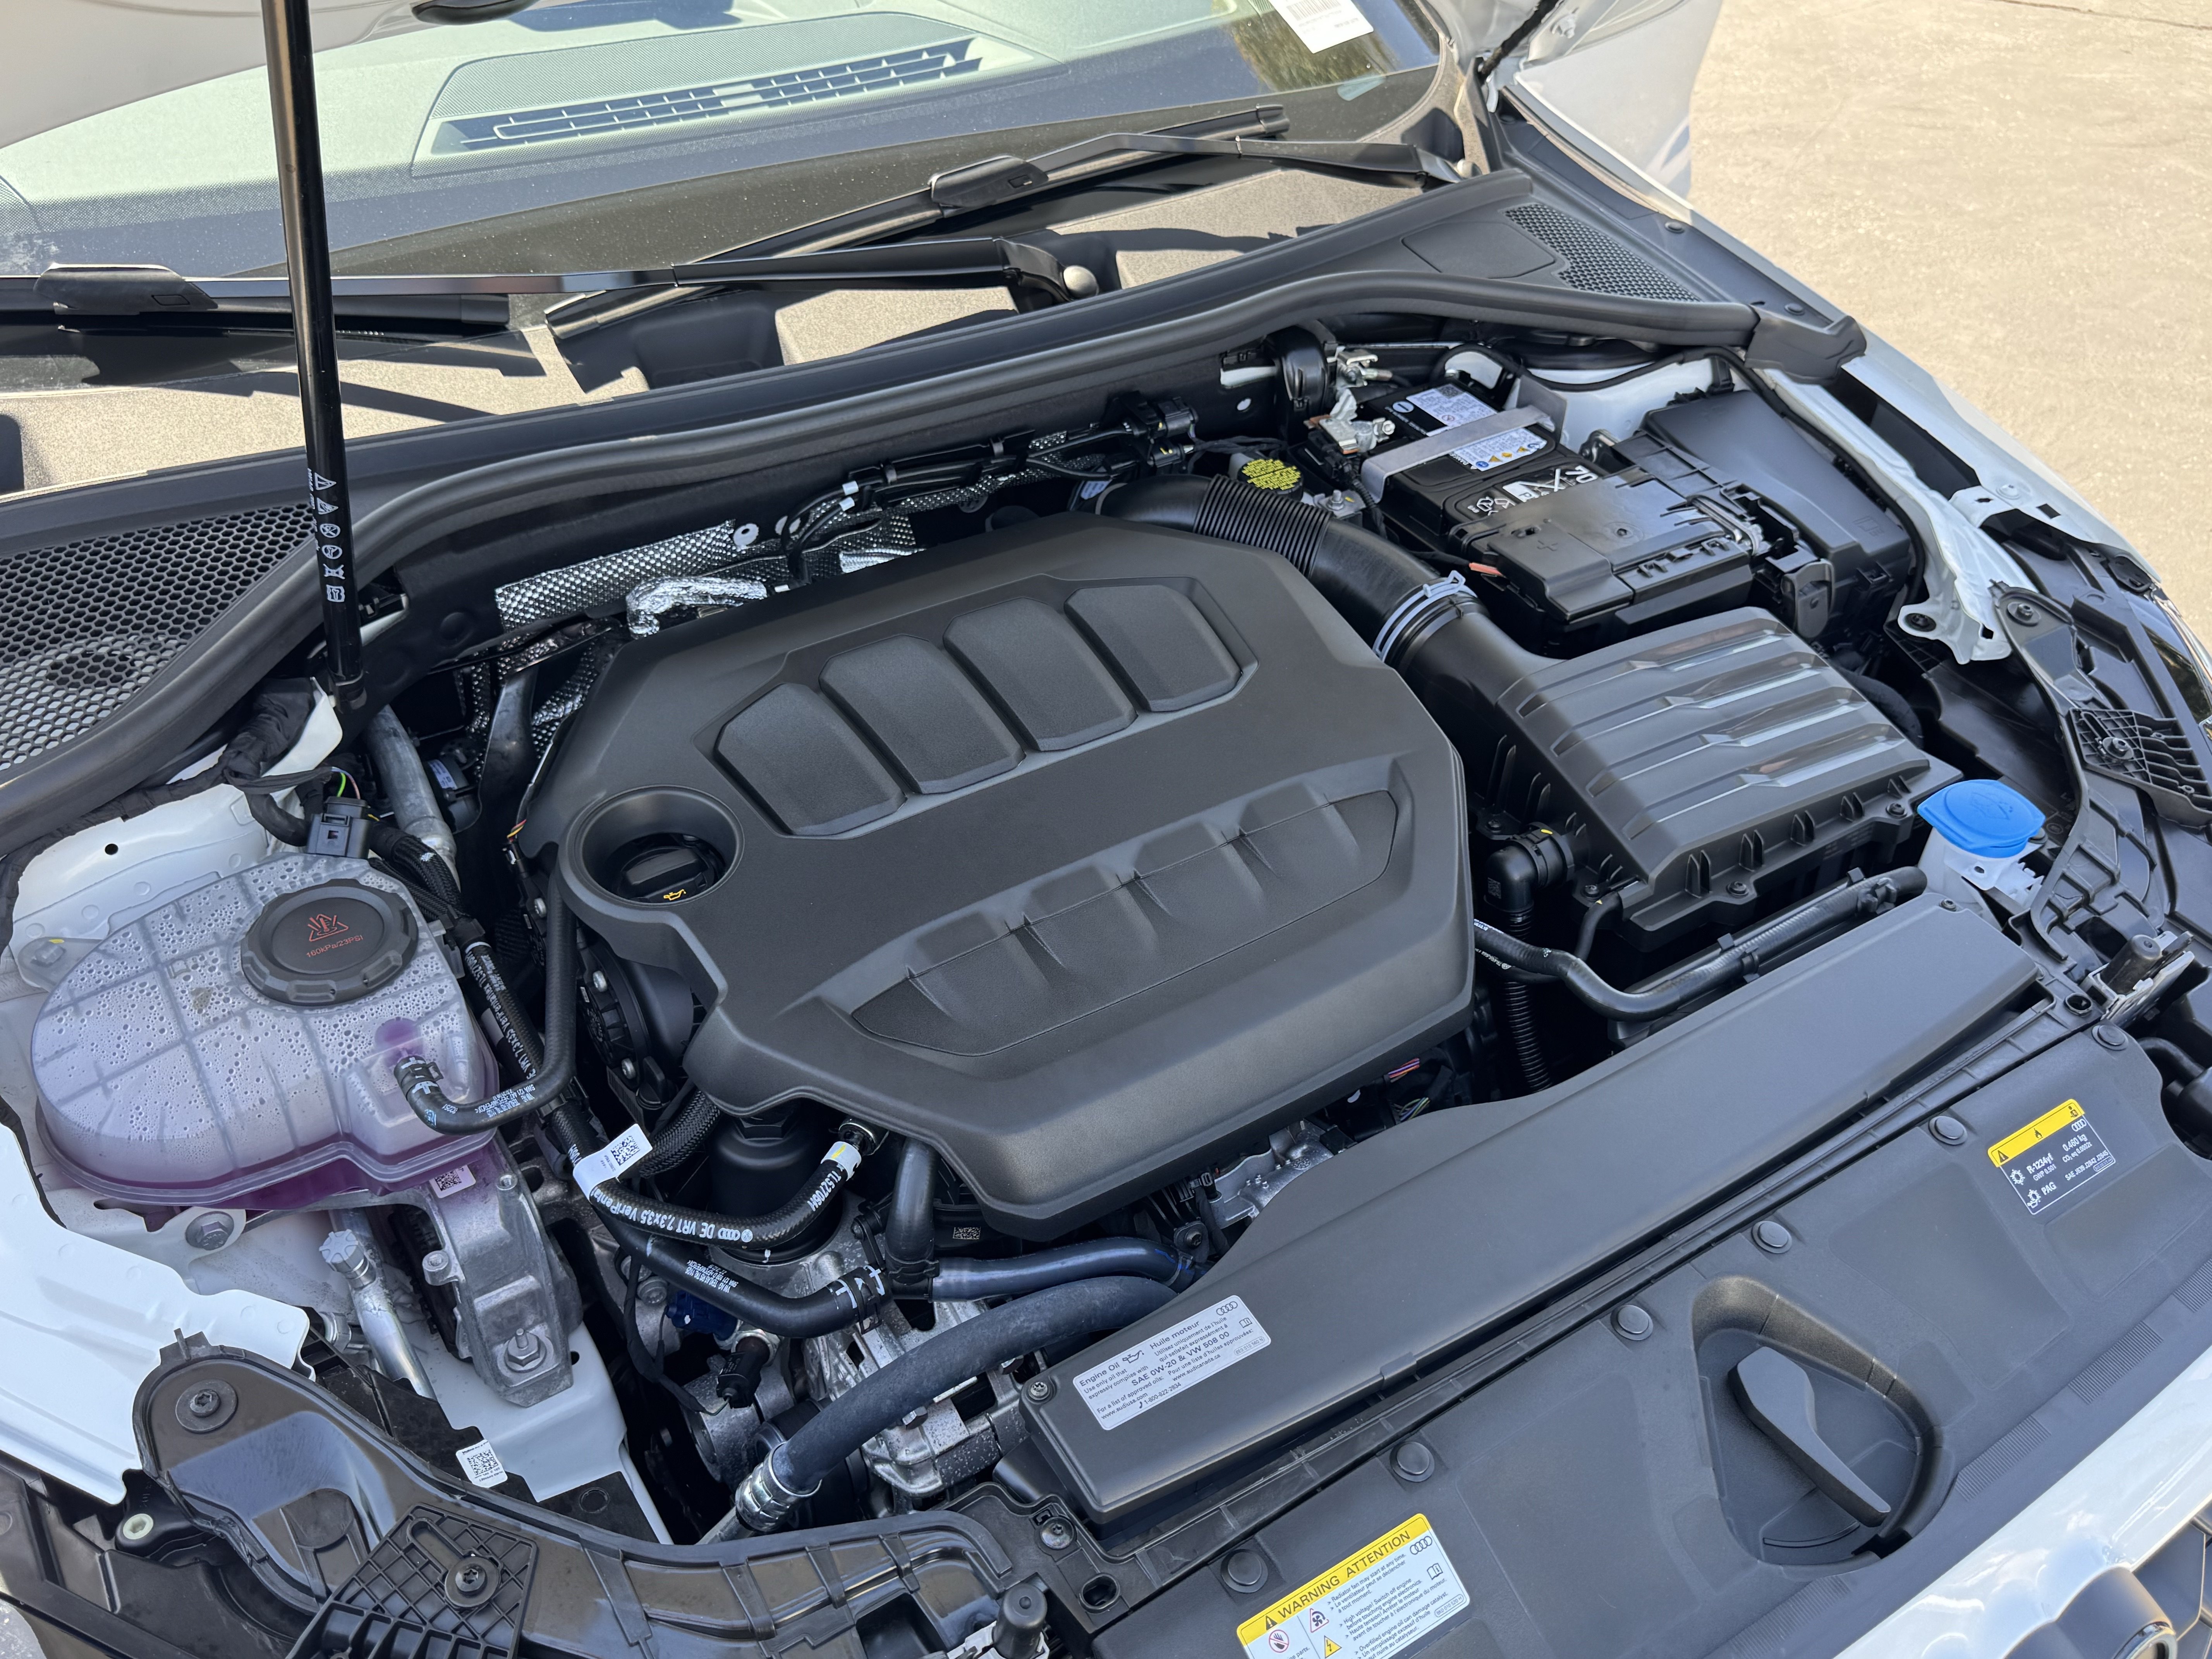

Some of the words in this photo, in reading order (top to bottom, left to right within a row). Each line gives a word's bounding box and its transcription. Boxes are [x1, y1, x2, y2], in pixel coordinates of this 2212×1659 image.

[2062, 1137, 2080, 1151] 0.460
[2076, 1133, 2088, 1142] kg
[2026, 1152, 2054, 1174] R-1234yf
[2032, 1170, 2044, 1181] GWP
[2064, 1170, 2076, 1181] SAE
[807, 1170, 841, 1211] TL52706H
[2040, 1181, 2057, 1195] PAG
[589, 1185, 639, 1221] VeriPenta
[640, 1209, 675, 1230] 7,3x3,5
[675, 1218, 696, 1235] VRT
[699, 1222, 715, 1239] DE
[1149, 1336, 1170, 1350] Huile
[1171, 1321, 1199, 1339] moteur
[1154, 1344, 1173, 1356] Utilisez
[1173, 1328, 1204, 1346] uniquement
[1131, 1373, 1150, 1386] SAE
[1150, 1359, 1177, 1376] 0W-20
[1185, 1345, 1201, 1356] VW
[1202, 1337, 1218, 1348] 508
[1218, 1331, 1230, 1340] 00
[1159, 1354, 1168, 1362] qui
[1168, 1344, 1189, 1357] satisfait
[1167, 1367, 1180, 1376] Pour
[1190, 1355, 1203, 1363] liste
[1079, 1370, 1107, 1386] Engine
[1108, 1362, 1120, 1371] Oil
[1083, 1386, 1096, 1394] Use
[1095, 1379, 1108, 1388] only
[1115, 1368, 1127, 1377] that
[1172, 1354, 1221, 1381] www.audicanada.ca
[1088, 1384, 1113, 1400] expressly
[1113, 1372, 1137, 1386] complies
[1136, 1365, 1149, 1374] with
[1127, 1381, 1152, 1398] approved
[1152, 1376, 1164, 1384] oils:
[1144, 1382, 1181, 1404] 1-800-822-2834
[1101, 1392, 1148, 1419] www.audiusa.com
[1277, 1575, 1340, 1618] WARNING
[1346, 1530, 1410, 1578] ATTENTION
[1331, 1587, 1351, 1602] Radiator
[1358, 1575, 1370, 1585] may
[1369, 1568, 1381, 1578] start
[1386, 1559, 1394, 1568] any
[1393, 1553, 1406, 1562] time.
[1341, 1585, 1365, 1603] ventilateur
[1365, 1578, 1376, 1589] peut
[1381, 1559, 1405, 1578] déclencher
[1341, 1602, 1352, 1611] tout
[1351, 1589, 1372, 1604] moment.
[1343, 1614, 1355, 1624] High
[1355, 1601, 1374, 1617] voltage!
[1373, 1592, 1390, 1605] Switch
[1396, 1578, 1412, 1590] engine
[1346, 1618, 1362, 1630] before
[1361, 1604, 1382, 1620] touching
[1382, 1595, 1398, 1607] engine
[1397, 1579, 1422, 1597] electronics.
[1349, 1624, 1364, 1635] Haute
[1363, 1611, 1382, 1626] tension!
[1403, 1587, 1419, 1601] moteur
[1352, 1630, 1366, 1641] avant
[1372, 1614, 1389, 1628] toucher
[1429, 1578, 1447, 1591] moteur.
[1358, 1634, 1382, 1652] Overfilled
[1381, 1625, 1397, 1637] engine
[1403, 1614, 1412, 1623] can
[1412, 1603, 1430, 1617] damage
[1430, 1591, 1448, 1605] catalyst.
[1370, 1632, 1397, 1652] remplissage
[1397, 1619, 1415, 1634] excessif
[1376, 1645, 1389, 1656] nuire
[1395, 1626, 1419, 1644] catalyseur.
[1295, 1646, 1310, 1658] parts.
